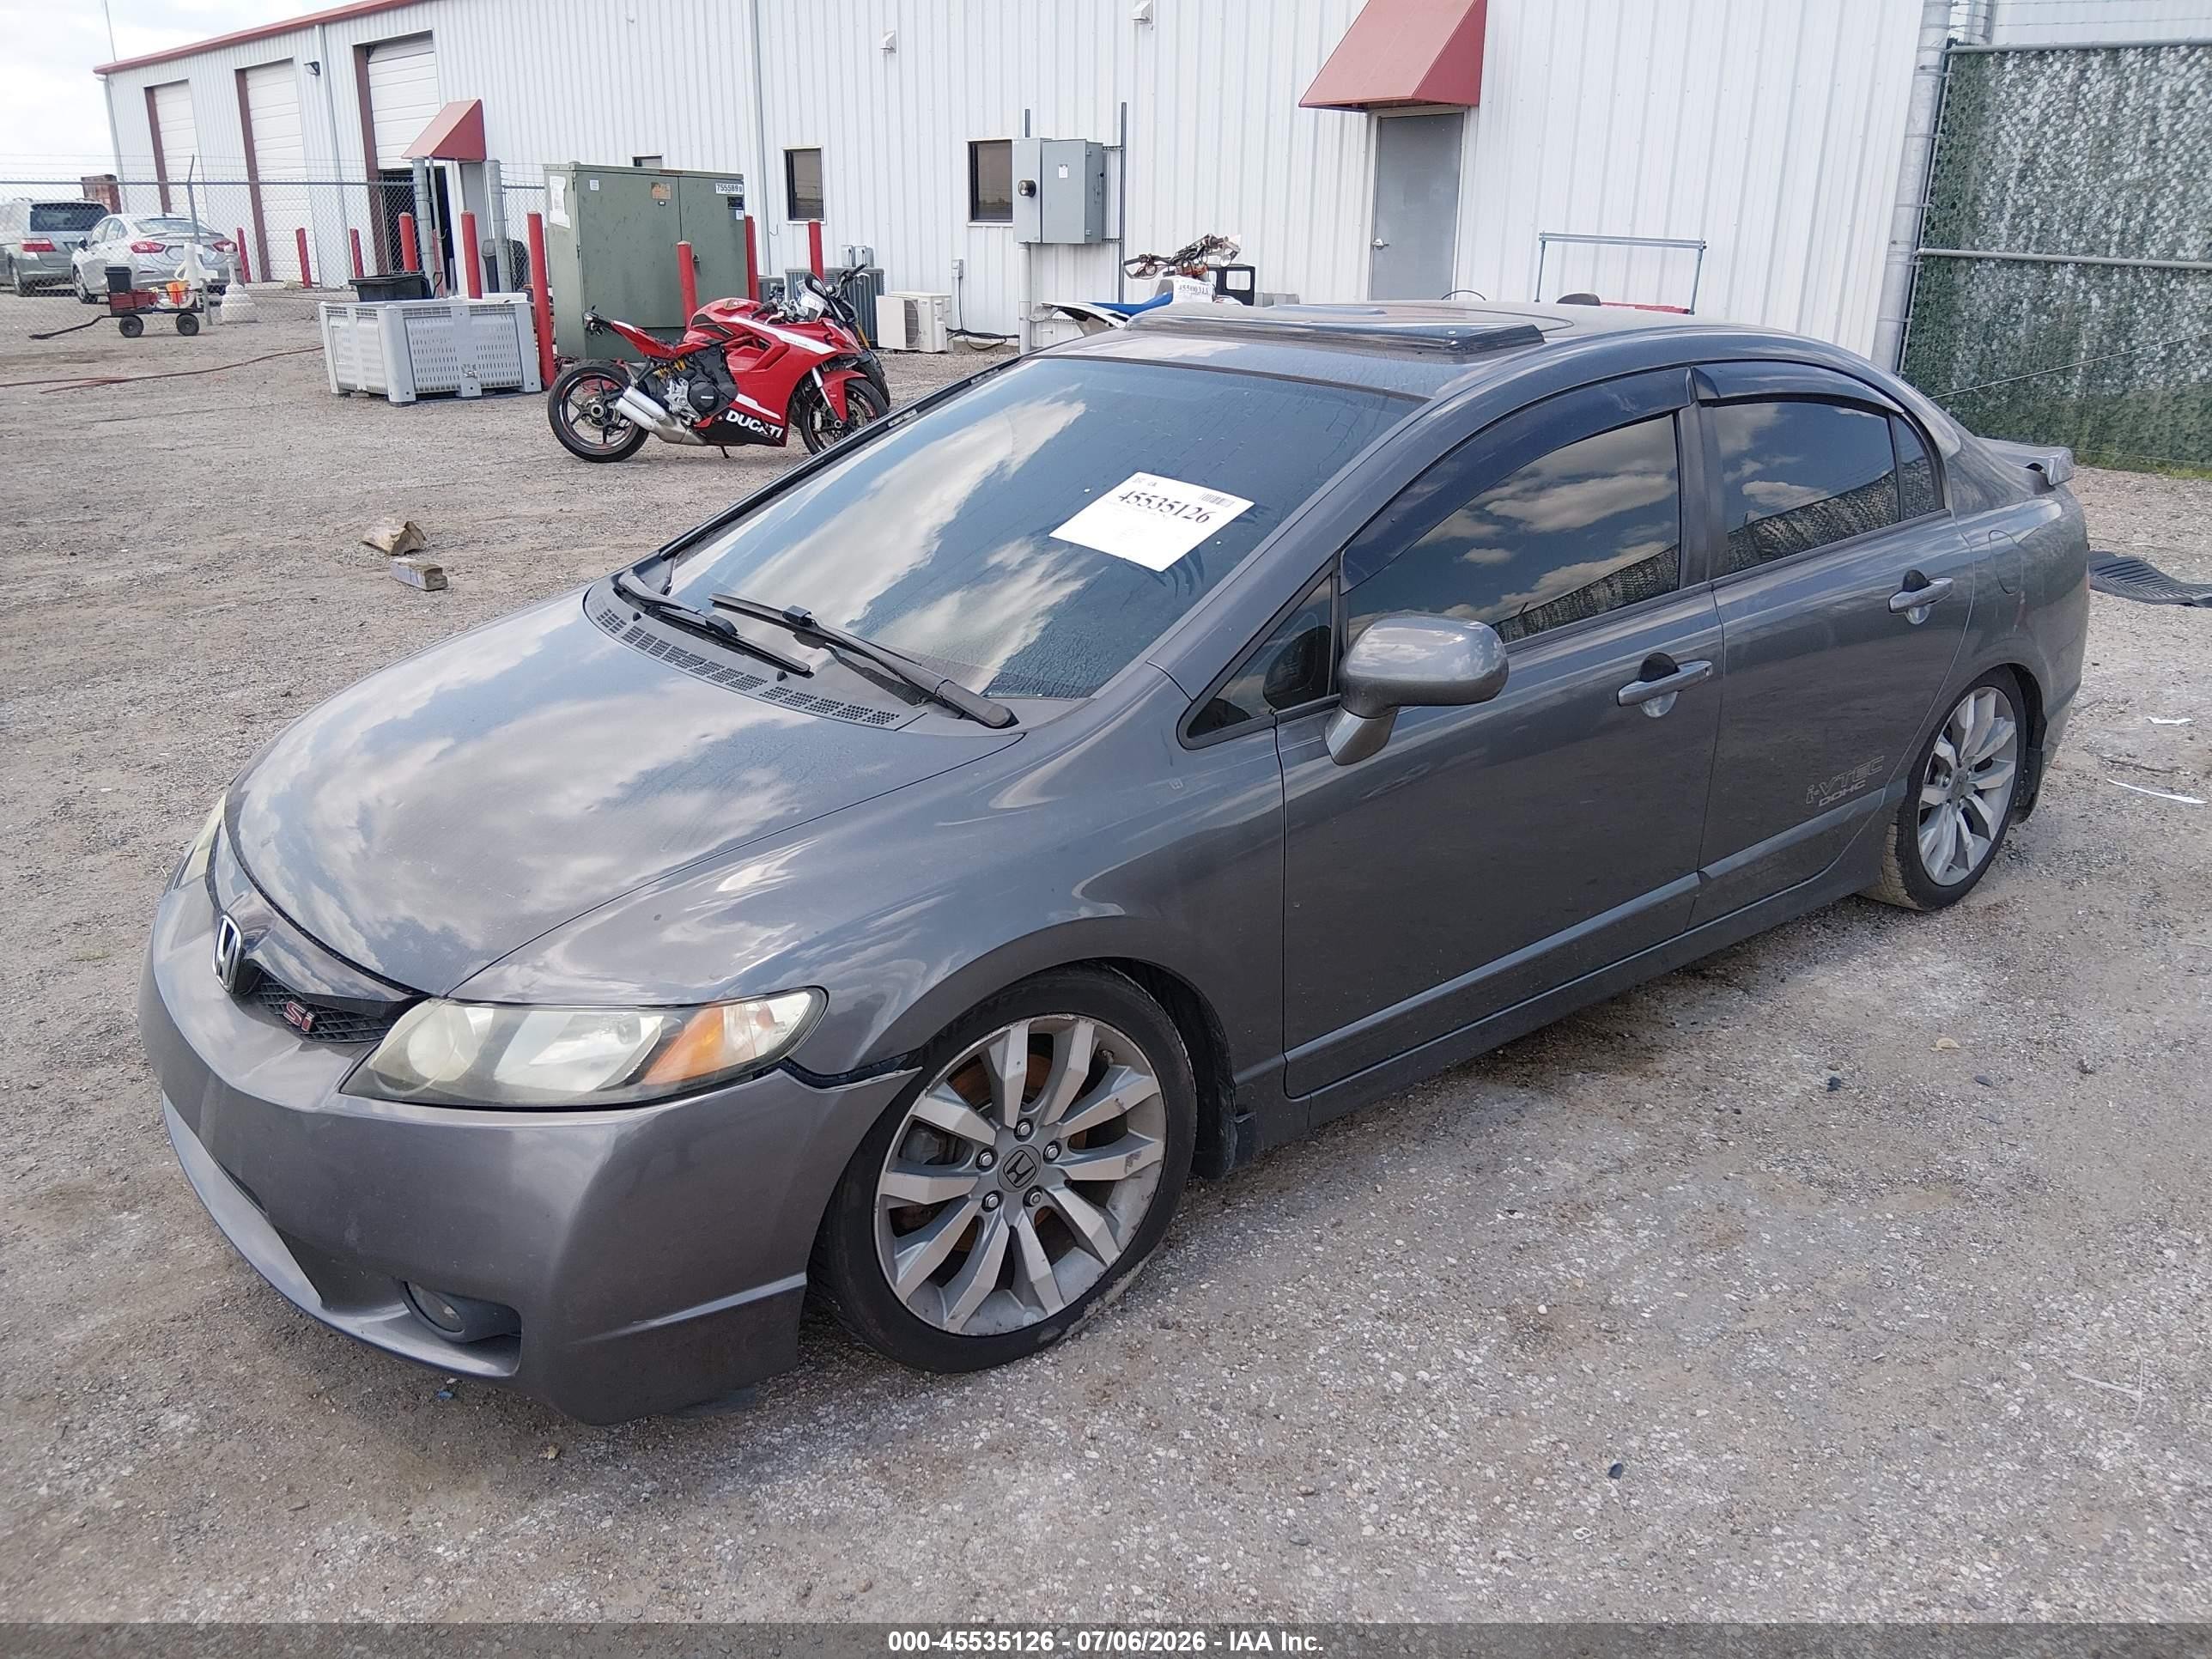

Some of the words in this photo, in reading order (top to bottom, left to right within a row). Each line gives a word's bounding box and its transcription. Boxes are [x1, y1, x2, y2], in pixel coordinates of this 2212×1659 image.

[726, 410, 784, 439] DUCATI
[1118, 490, 1217, 524] 45535126
[1819, 779, 1867, 807] DOHC
[283, 1000, 315, 1032] Si
